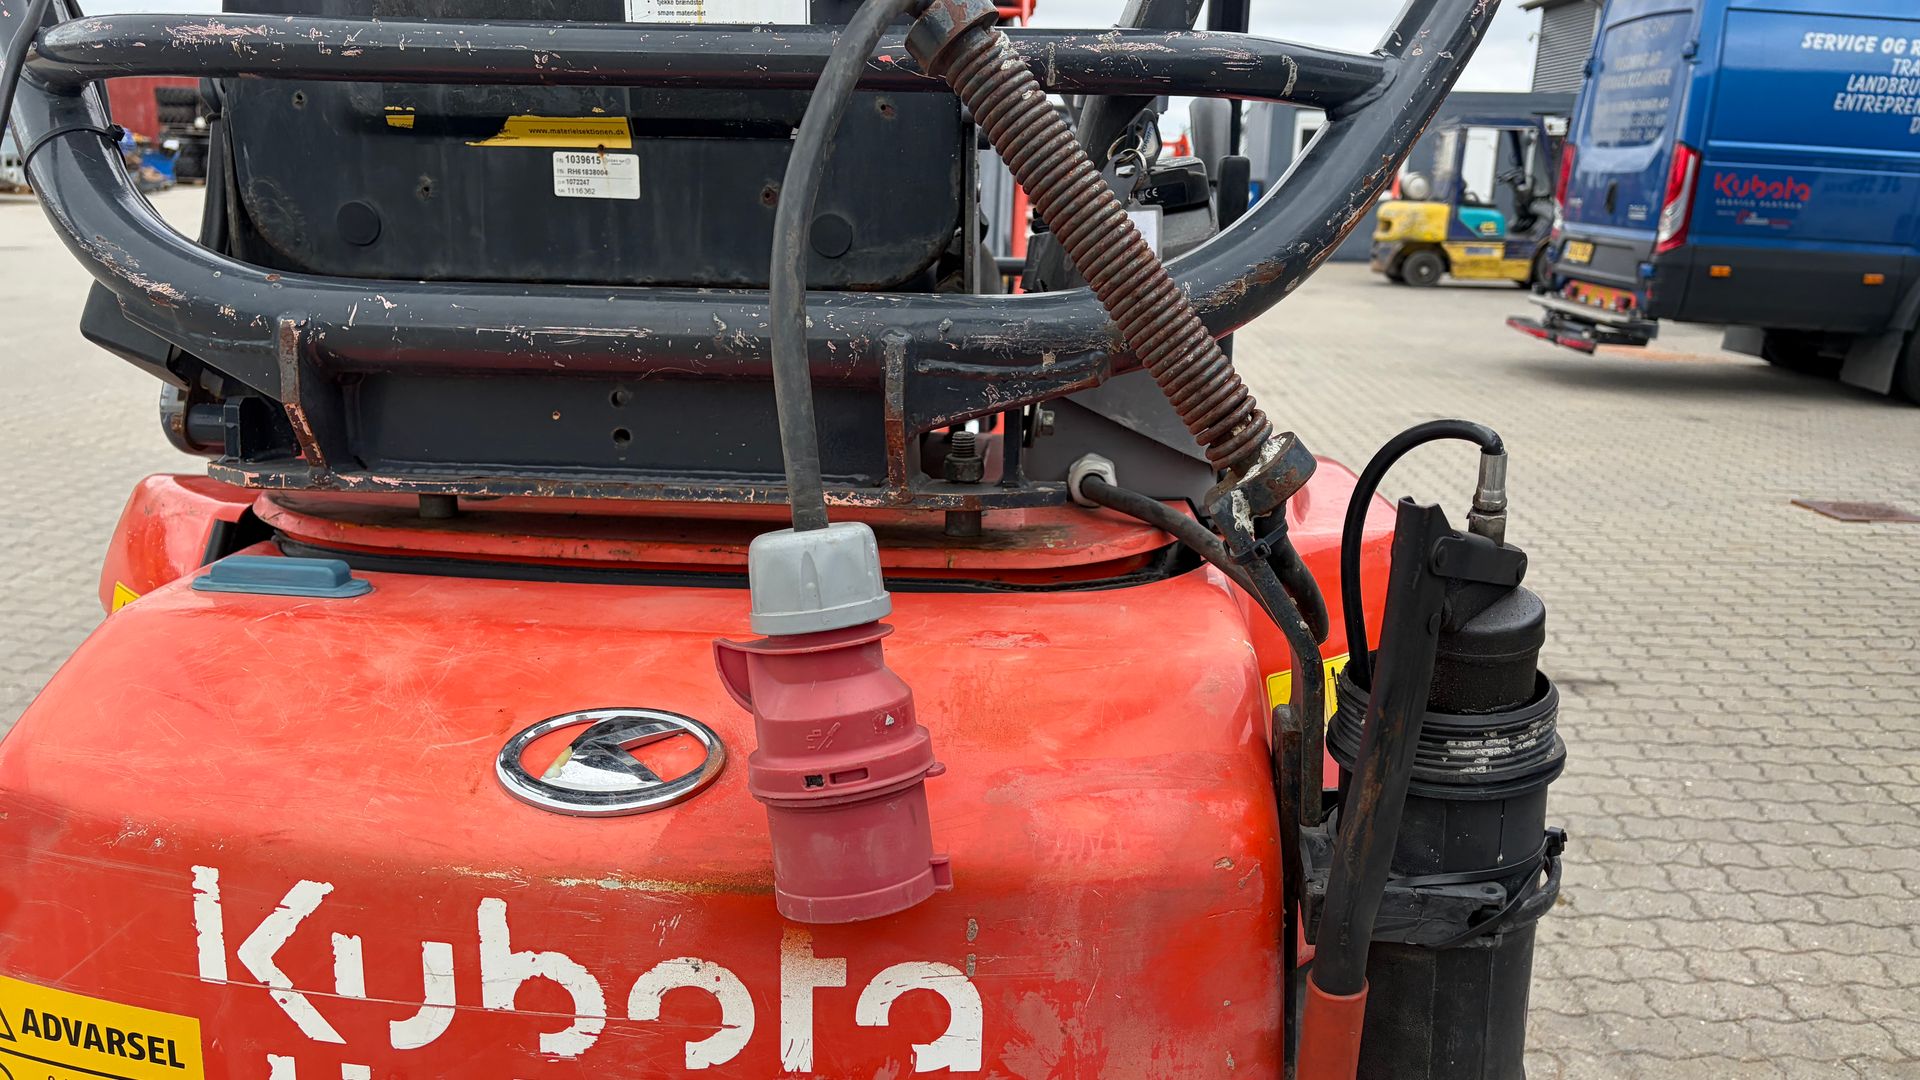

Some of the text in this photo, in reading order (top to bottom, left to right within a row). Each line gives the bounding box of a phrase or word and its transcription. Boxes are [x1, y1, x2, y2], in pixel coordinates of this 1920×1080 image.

[1801, 32, 1878, 53] SERVICE
[1882, 37, 1907, 55] OG
[528, 127, 625, 136] www.materielsektionen.dk
[565, 155, 602, 165] 1039615
[1714, 172, 1811, 201] Kubota
[191, 865, 983, 1073] Kubota
[21, 1007, 186, 1070] ADVARSEL
